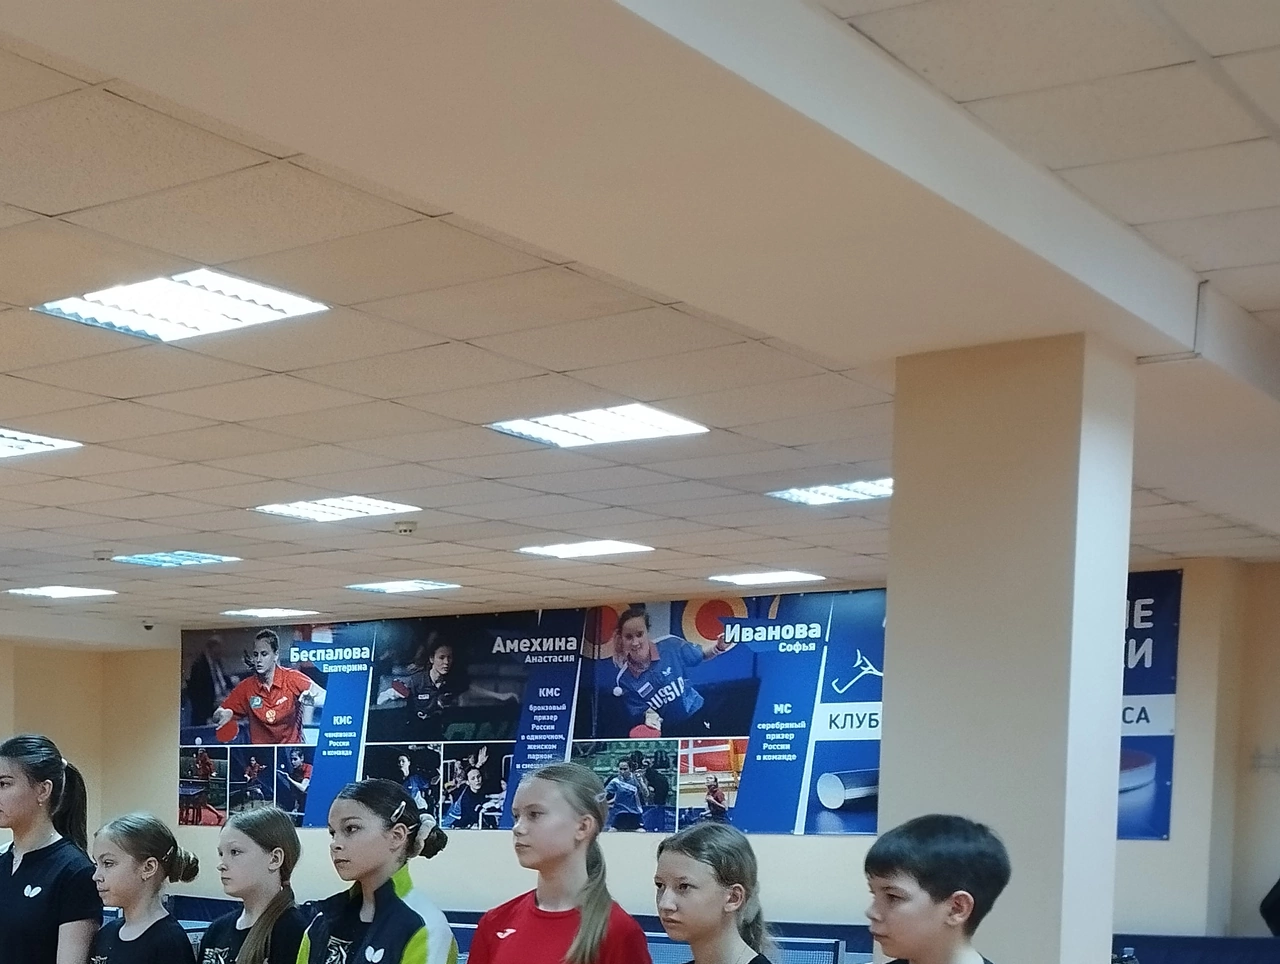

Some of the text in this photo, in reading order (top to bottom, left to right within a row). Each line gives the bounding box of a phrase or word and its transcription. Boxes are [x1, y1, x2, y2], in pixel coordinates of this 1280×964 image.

[724, 622, 822, 643] Иванова
[491, 635, 578, 654] Амехина
[778, 640, 816, 654] Софья
[289, 646, 371, 662] Беспалова
[524, 654, 575, 664] Анастасия
[322, 663, 368, 673] Екатерина
[538, 687, 561, 697] КМС
[528, 703, 567, 713] бронзовый
[773, 703, 793, 715] МС
[333, 715, 353, 725] КМС
[533, 714, 558, 722] призер
[828, 712, 880, 730] КЛУБ
[531, 723, 555, 731] России
[756, 720, 807, 731] серебряный
[765, 732, 795, 741] призер
[328, 739, 350, 747] России
[762, 742, 791, 750] России
[762, 753, 797, 762] команде
